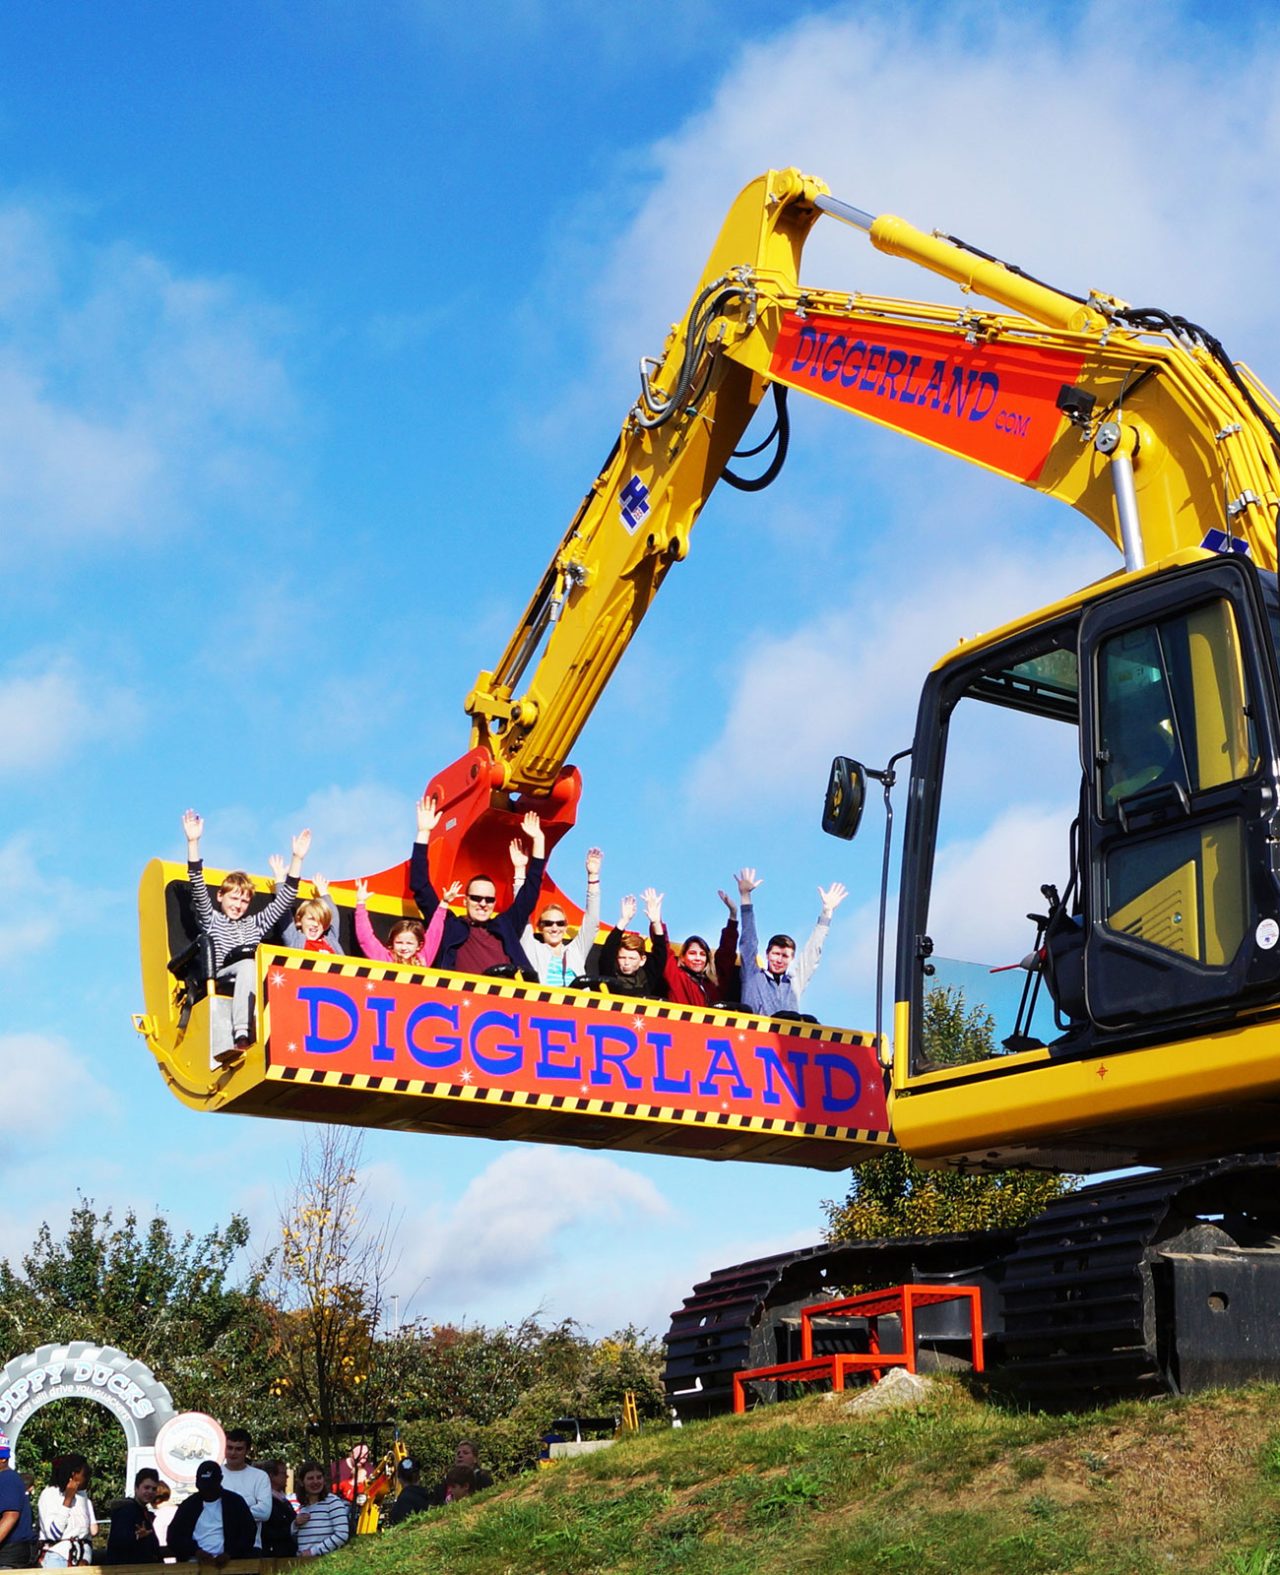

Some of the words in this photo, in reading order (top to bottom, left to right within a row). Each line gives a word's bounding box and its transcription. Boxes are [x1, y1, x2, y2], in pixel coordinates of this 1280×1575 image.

[792, 326, 1000, 421] DIGGERLAND
[297, 985, 863, 1113] DIGGERLAND
[0, 1362, 66, 1423] DIPPY
[73, 1361, 155, 1419] DUCKS
[12, 1402, 32, 1423] They
[32, 1392, 48, 1406] will
[49, 1384, 75, 1397] drive
[76, 1384, 93, 1395] you
